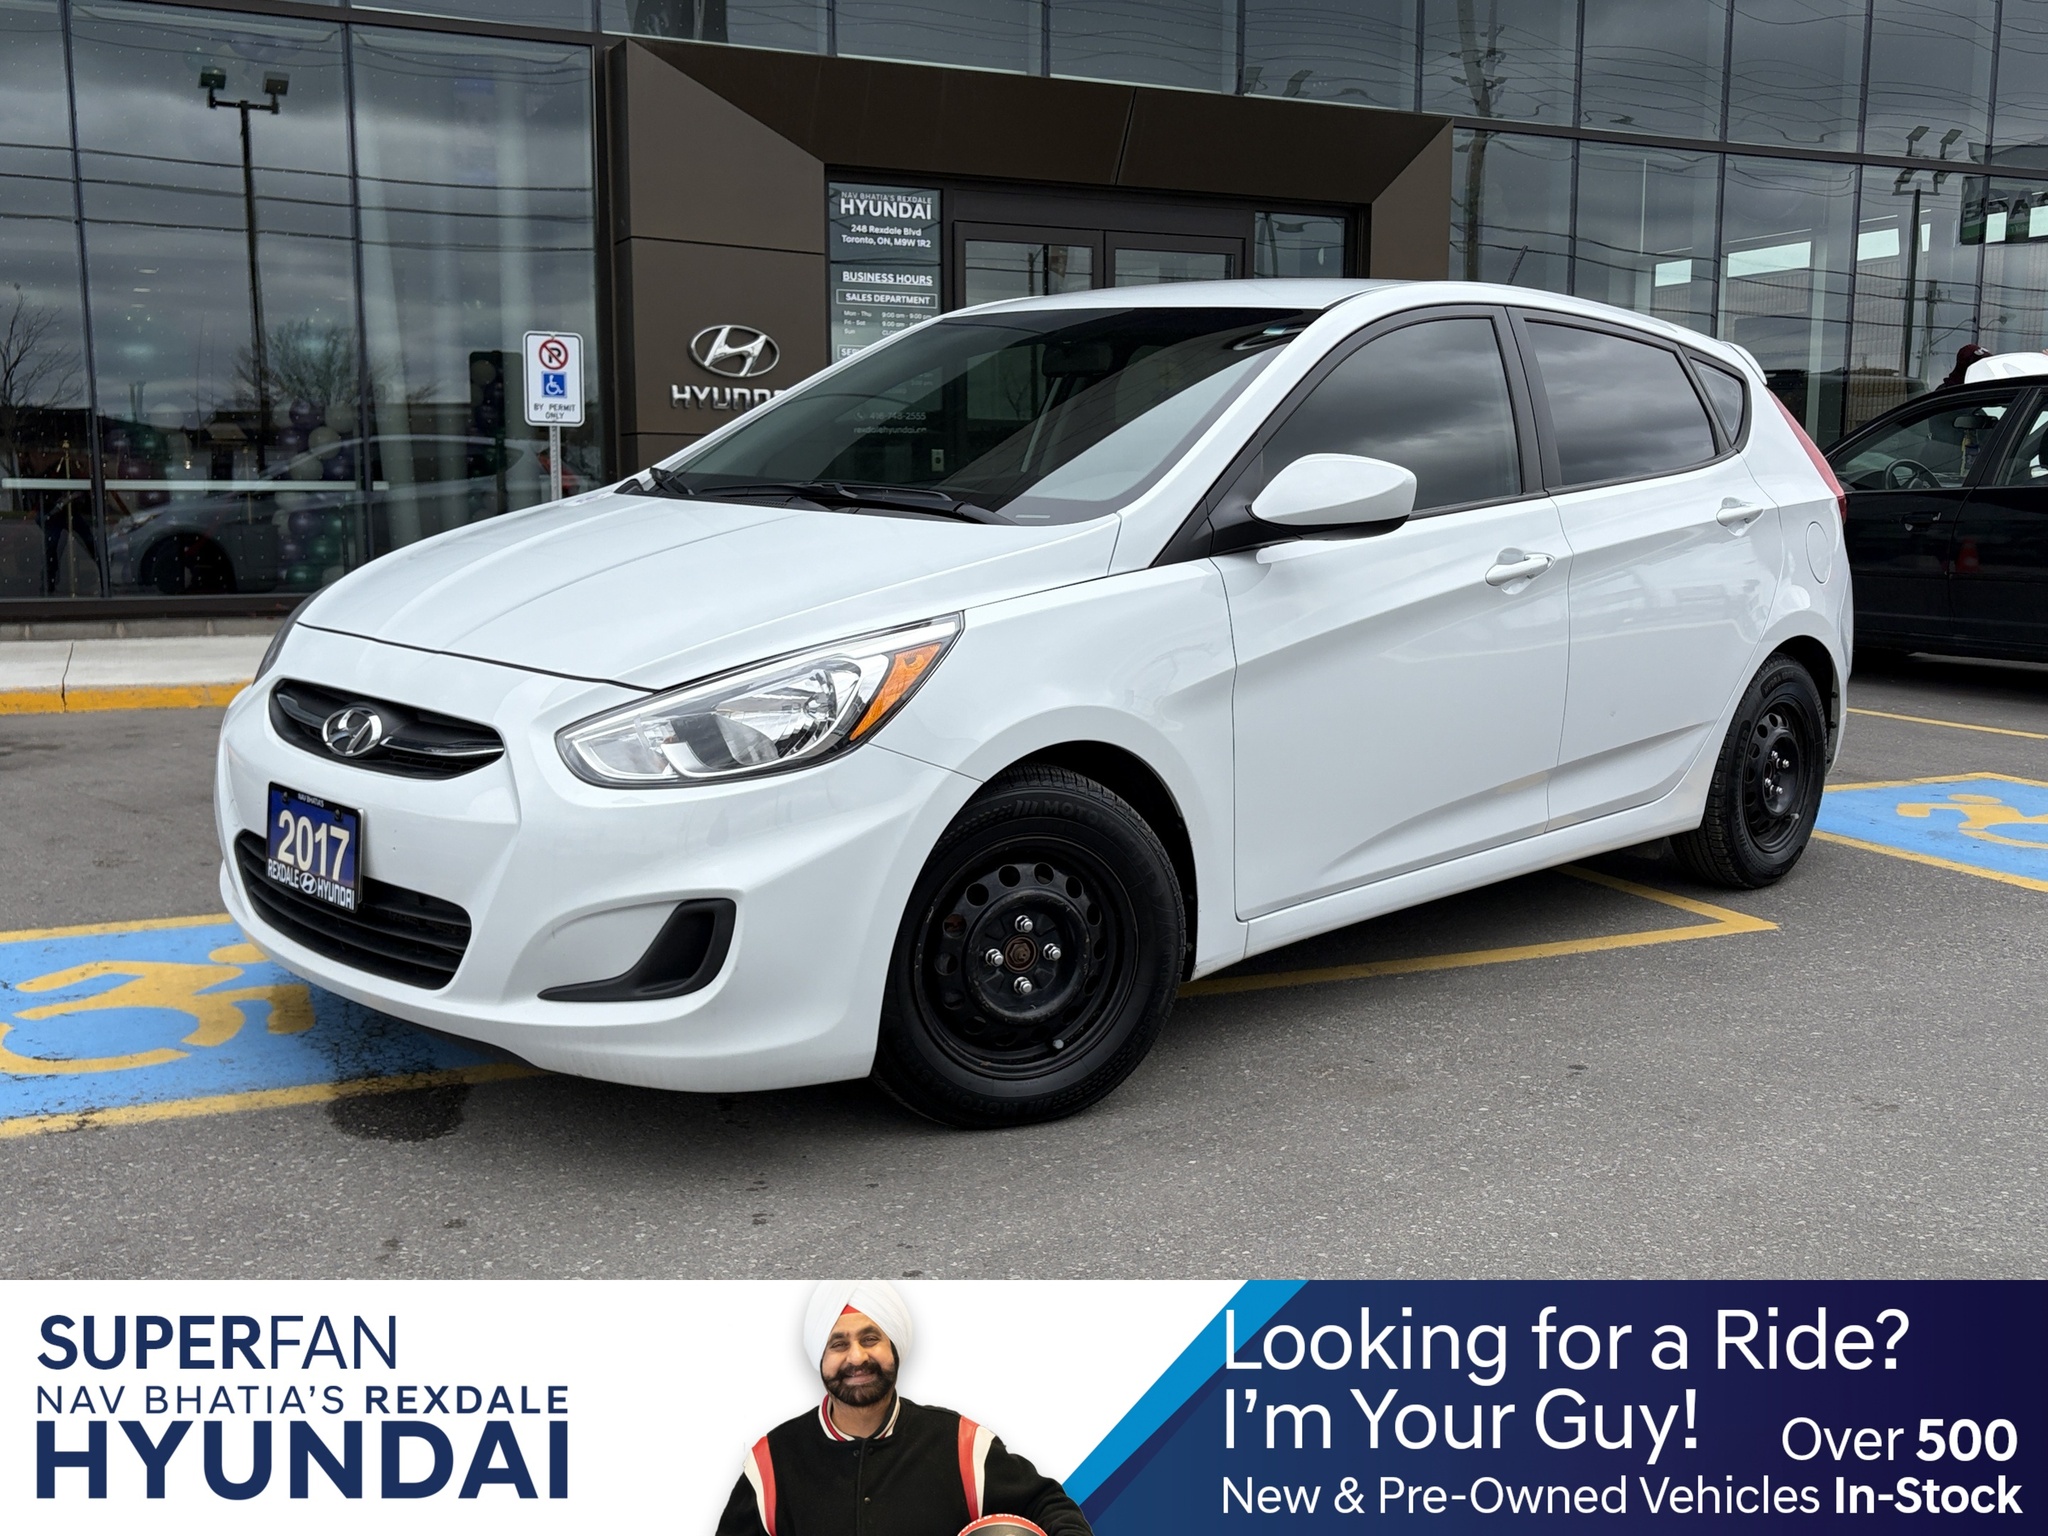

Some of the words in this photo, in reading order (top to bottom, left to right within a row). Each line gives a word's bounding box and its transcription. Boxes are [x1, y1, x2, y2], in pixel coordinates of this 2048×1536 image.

[860, 193, 895, 201] BHATIA'S
[897, 196, 932, 204] REXDALE
[841, 198, 931, 220] HYUNDAI
[851, 224, 868, 233] 248
[869, 225, 902, 235] Rexdale
[903, 228, 922, 236] Blvd
[842, 235, 876, 245] Toronto,
[877, 237, 893, 246] ON,
[894, 238, 916, 247] M9W
[917, 240, 931, 248] 1R2
[842, 271, 894, 282] BUSINESS
[896, 274, 933, 285] HOURS
[845, 293, 872, 302] SALES
[874, 294, 930, 305] DEPARTMENT
[533, 403, 544, 411] BY
[549, 403, 576, 412] PERMIT
[545, 411, 565, 419] ONLY
[277, 809, 350, 882] 2017
[267, 858, 300, 889] REXDALE
[317, 877, 355, 911] HYUNDAI
